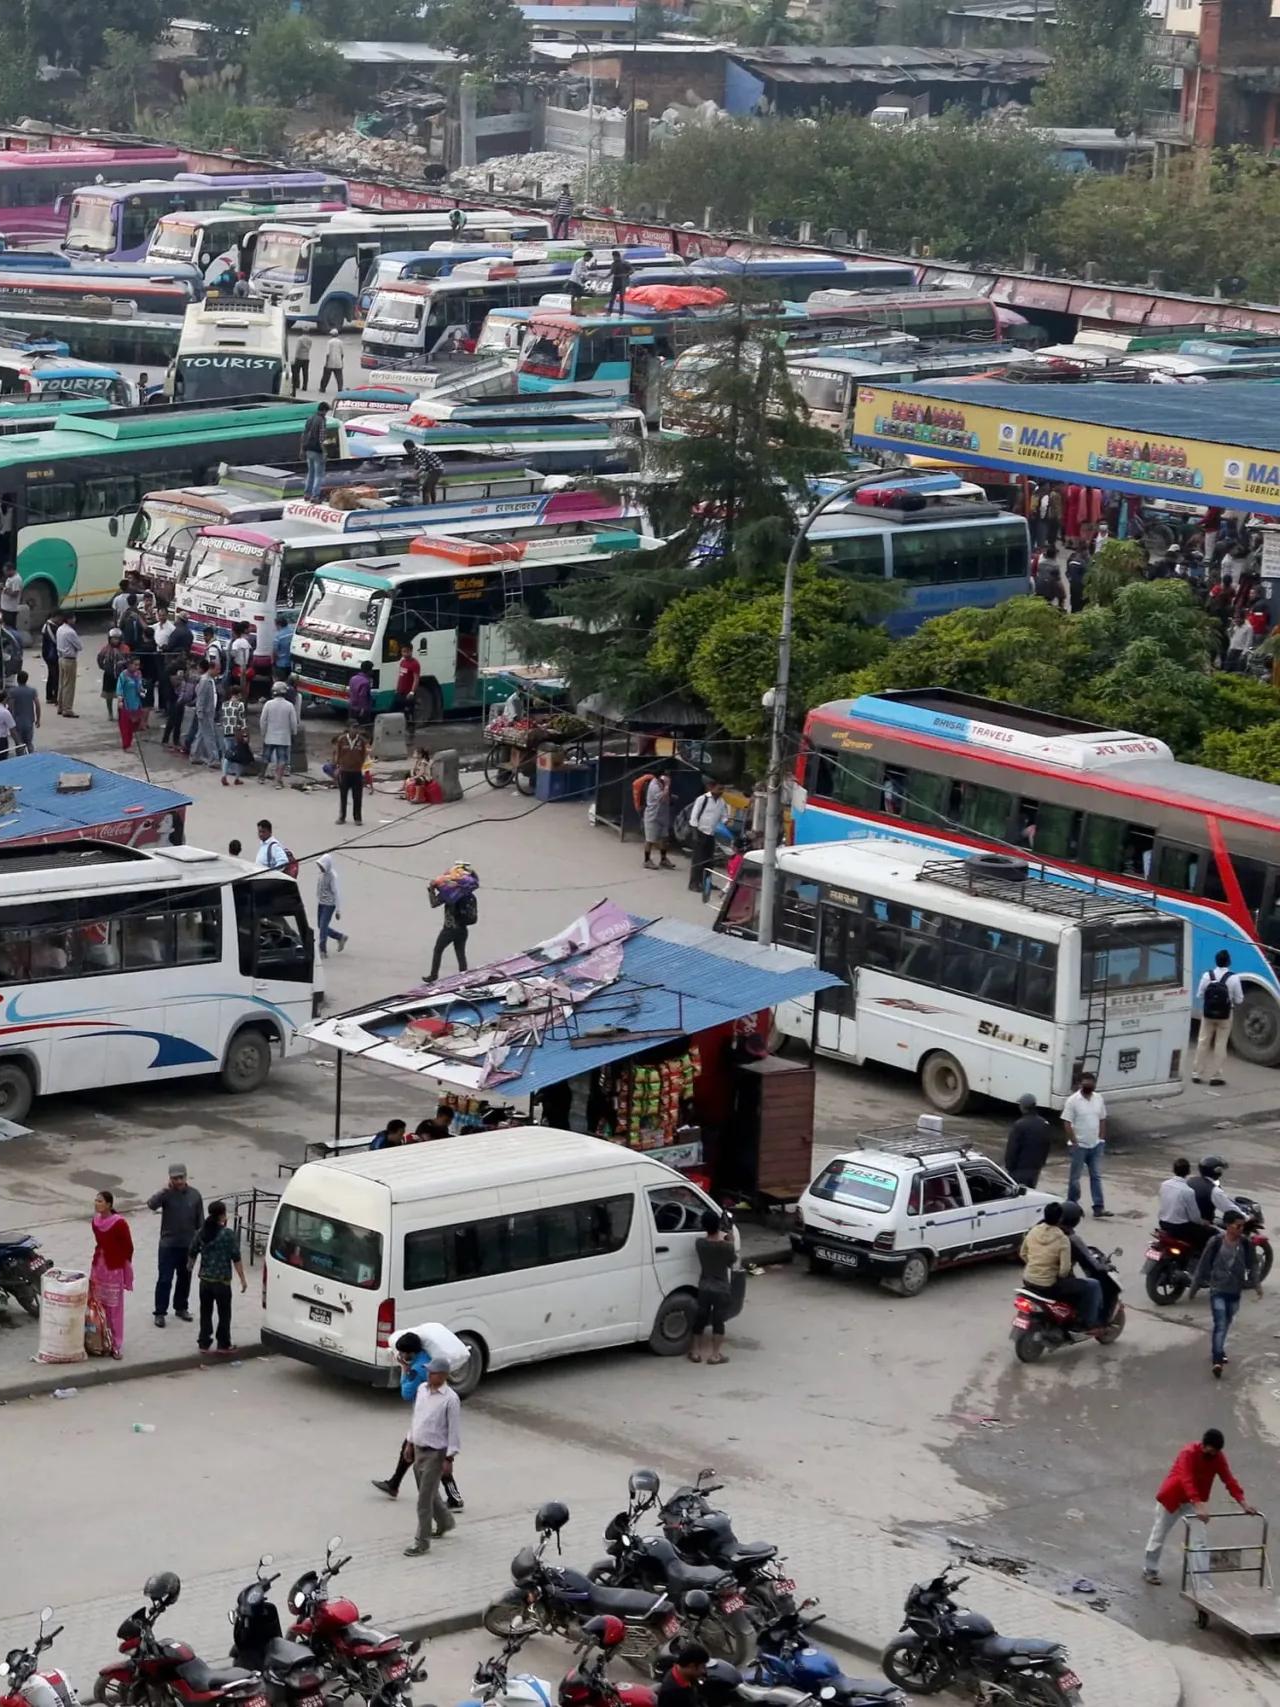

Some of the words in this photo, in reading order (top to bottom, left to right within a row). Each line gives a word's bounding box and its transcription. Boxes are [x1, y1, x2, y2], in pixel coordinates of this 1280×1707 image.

[13, 287, 34, 295] FREE
[584, 281, 613, 293] SALEE
[182, 356, 278, 370] TOURIST
[40, 378, 113, 391] TOURIST
[1019, 425, 1066, 453] MAK
[1017, 445, 1065, 463] LUBRICANTS
[1246, 463, 1280, 486] MA
[1244, 482, 1280, 498] LUBRICA
[932, 717, 966, 732] BHUSAL
[971, 726, 1015, 744] TRAVELS
[98, 819, 133, 838] Coca-Cola
